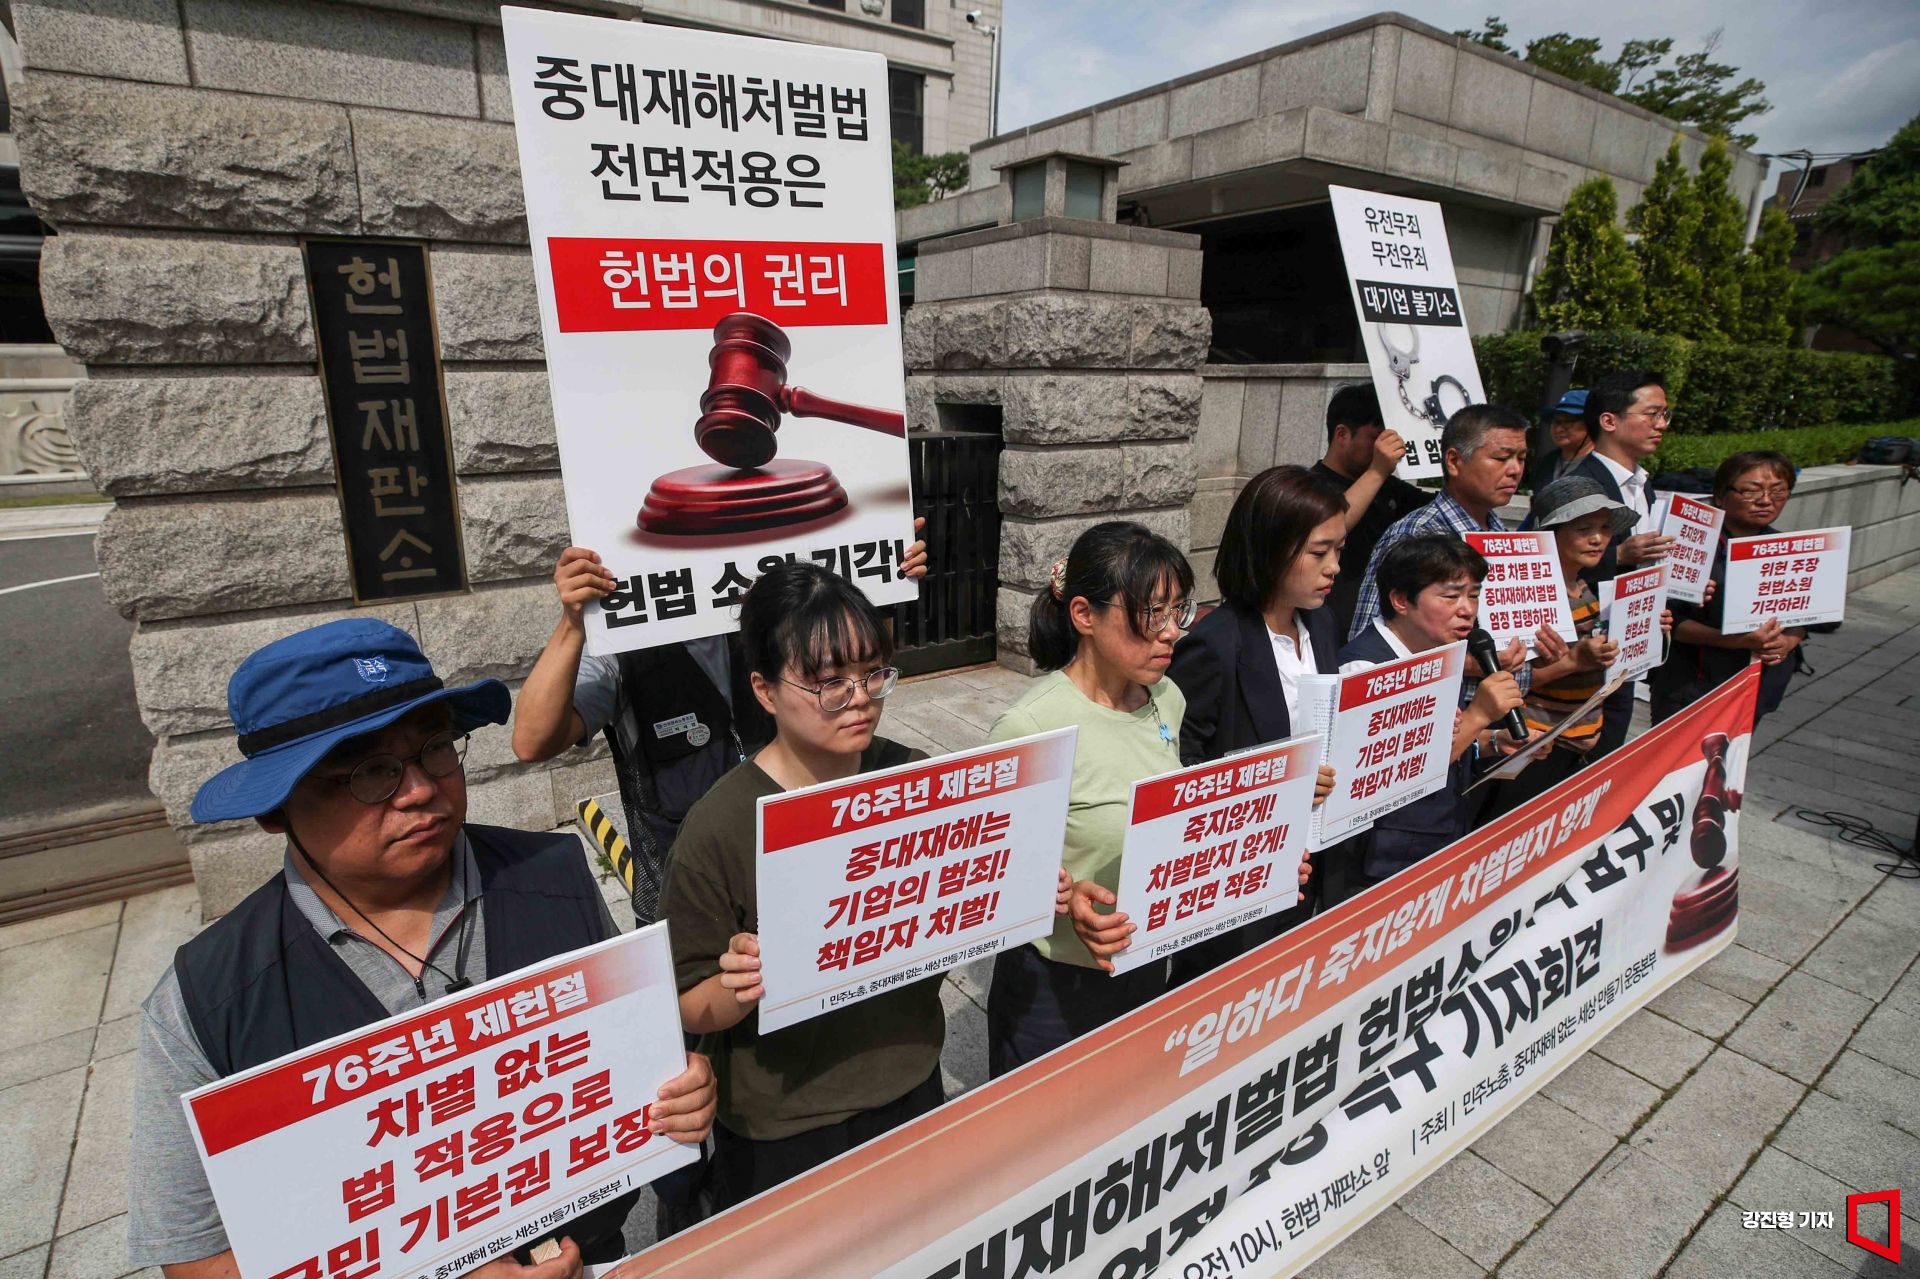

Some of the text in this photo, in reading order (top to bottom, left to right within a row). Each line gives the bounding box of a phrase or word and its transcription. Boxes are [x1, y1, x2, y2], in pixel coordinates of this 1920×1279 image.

[533, 55, 868, 141] 중대재해처벌법
[590, 143, 826, 208] 전면적용은
[1364, 207, 1421, 239] 유전무죄
[600, 250, 848, 310] 헌법의 권리
[1371, 241, 1428, 271] 무전유죄
[1363, 286, 1456, 318] 대기업 불기소
[338, 257, 437, 582] 헌법재판소
[1424, 439, 1442, 465] 엄
[1483, 537, 1540, 554] 76주년 제헌절
[1508, 562, 1529, 580] 차별
[1531, 561, 1553, 579] 말고
[1752, 537, 1825, 557] 76주년 제헌절
[1760, 557, 1820, 577] 위헌 주장
[600, 567, 697, 629] 헌법
[1485, 584, 1557, 607] 중대재해처벌법
[1750, 596, 1811, 614] 기각하라!
[1758, 576, 1813, 596] 헌법소원
[1489, 607, 1558, 631] 엄정 집행하라!
[1365, 657, 1443, 698] 76주년 제헌절
[1356, 722, 1434, 769] 기업의 범죄!
[1367, 694, 1437, 737] 중대재해는
[831, 755, 1020, 829] 76주년 제헌절
[1172, 755, 1288, 807] 76주년 제헌절
[1350, 752, 1428, 801] 책임자 처벌!
[845, 810, 1012, 882] 중대재해는
[1183, 793, 1278, 844] 죽지않게!
[1648, 792, 1685, 857] 및
[823, 848, 1012, 930] 기업의 범죄!
[1145, 839, 1238, 893] 차별받지
[1240, 823, 1290, 863] 않게!
[1146, 863, 1273, 932] 법 전면 적용!
[1318, 875, 1456, 990] 죽지않게
[1452, 813, 1557, 911] 차별받지
[816, 891, 1001, 972] 책임자 처벌!
[829, 939, 1000, 1006] 민주노총, 중대재해 없는 세상 만들기 운동본부
[1440, 918, 1604, 1058] 기자회견
[302, 970, 589, 1103] 76주년 제헌절
[367, 1030, 591, 1148] 차별 없는
[1229, 1219, 1283, 1269] 10시,
[1281, 1192, 1321, 1241] 헌법
[1320, 1162, 1373, 1213] 재판소
[1373, 1148, 1391, 1177] 앞
[1420, 1107, 1448, 1145] 주최
[1463, 1063, 1512, 1116] 민주노총,
[1514, 1026, 1556, 1078] 중대재해
[1557, 1014, 1576, 1045] 없는
[1577, 1001, 1596, 1029] 세상
[1597, 974, 1624, 1011] 만들기
[1624, 949, 1657, 990] 운동본부
[342, 1069, 613, 1224] 법 적용으로
[400, 1149, 551, 1254] 기본권
[435, 1181, 623, 1279] 중대재해 없는 세상 만들기 운동본부
